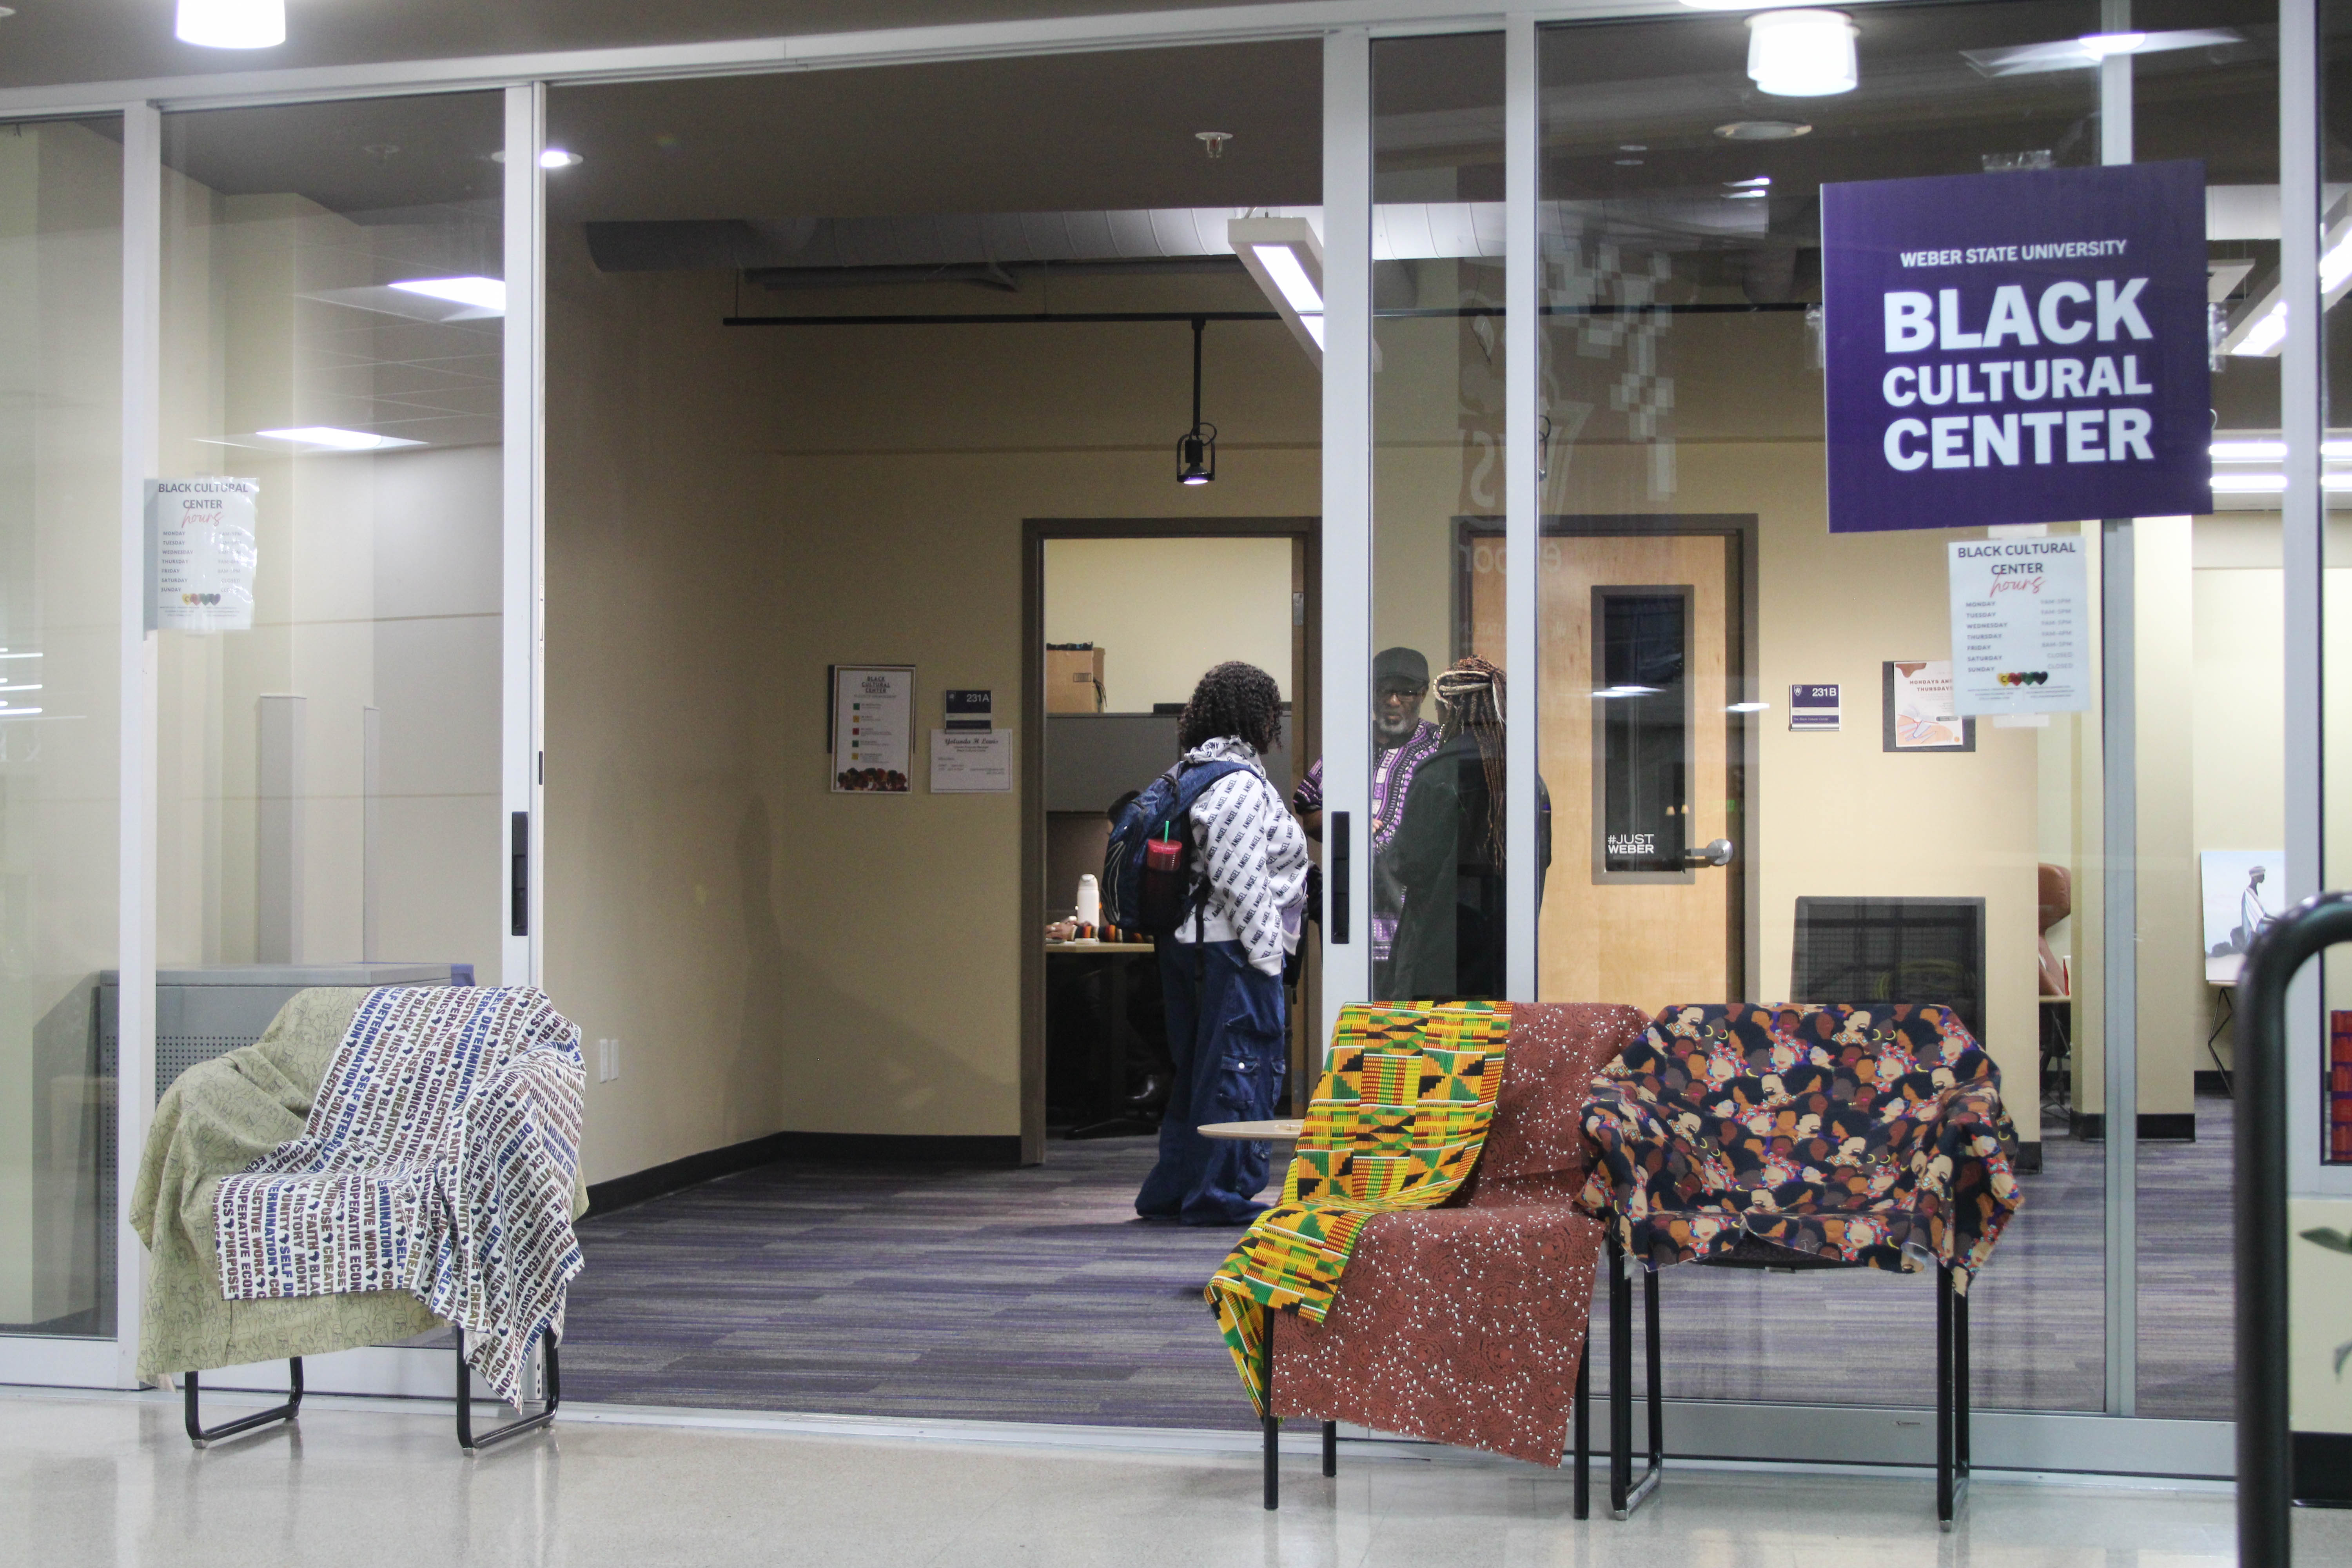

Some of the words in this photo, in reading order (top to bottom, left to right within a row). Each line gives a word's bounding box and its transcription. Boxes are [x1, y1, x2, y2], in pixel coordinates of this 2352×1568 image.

[1900, 249, 1962, 267] WEBER
[1965, 245, 2018, 263] STATE
[2022, 239, 2128, 260] UNIVERSITY
[1884, 277, 2153, 353] BLACK
[1883, 355, 2152, 408] CULTURAL
[1883, 408, 2154, 472] CENTER
[158, 483, 192, 492] BLACK
[194, 483, 248, 492] CULTURAL
[183, 499, 223, 509] CENTER
[181, 507, 224, 528] hours
[1958, 546, 2001, 558] BLACK
[2005, 542, 2076, 555] CULTURAL
[1991, 563, 2043, 575] CENTER
[1989, 571, 2046, 597] hours
[966, 693, 990, 702] 231A
[1812, 687, 1837, 697] 231B
[1215, 797, 1228, 810] ANGEL
[1224, 780, 1237, 793] ANGEL
[1207, 846, 1218, 861] ANGEL
[1215, 828, 1227, 843] ANGEL
[1224, 811, 1238, 826] ANGEL
[1234, 794, 1247, 809] ANGEL
[1243, 779, 1255, 793] ANGEL
[1273, 807, 1283, 822] ANGEL
[1212, 867, 1224, 882] ANGEL
[1222, 849, 1234, 864] ANGEL
[1231, 831, 1245, 847] ANGEL
[1243, 813, 1255, 829] ANGEL
[1608, 834, 1654, 844] #JUST
[1608, 844, 1654, 854] WEBER
[1227, 870, 1240, 885] ANGEL
[1238, 853, 1251, 869] ANGEL
[1249, 835, 1261, 851] ANGEL
[1294, 843, 1304, 858] ANGEL
[1234, 892, 1247, 907] ANGEL
[1244, 875, 1258, 891] ANGEL
[1276, 884, 1290, 897] ANGEL
[1243, 909, 1256, 924] ANGEL
[1253, 892, 1264, 908] ANGEL
[1250, 930, 1264, 945] ANGEL
[1261, 911, 1270, 927] ANGEL
[1268, 931, 1278, 947] ANGEL
